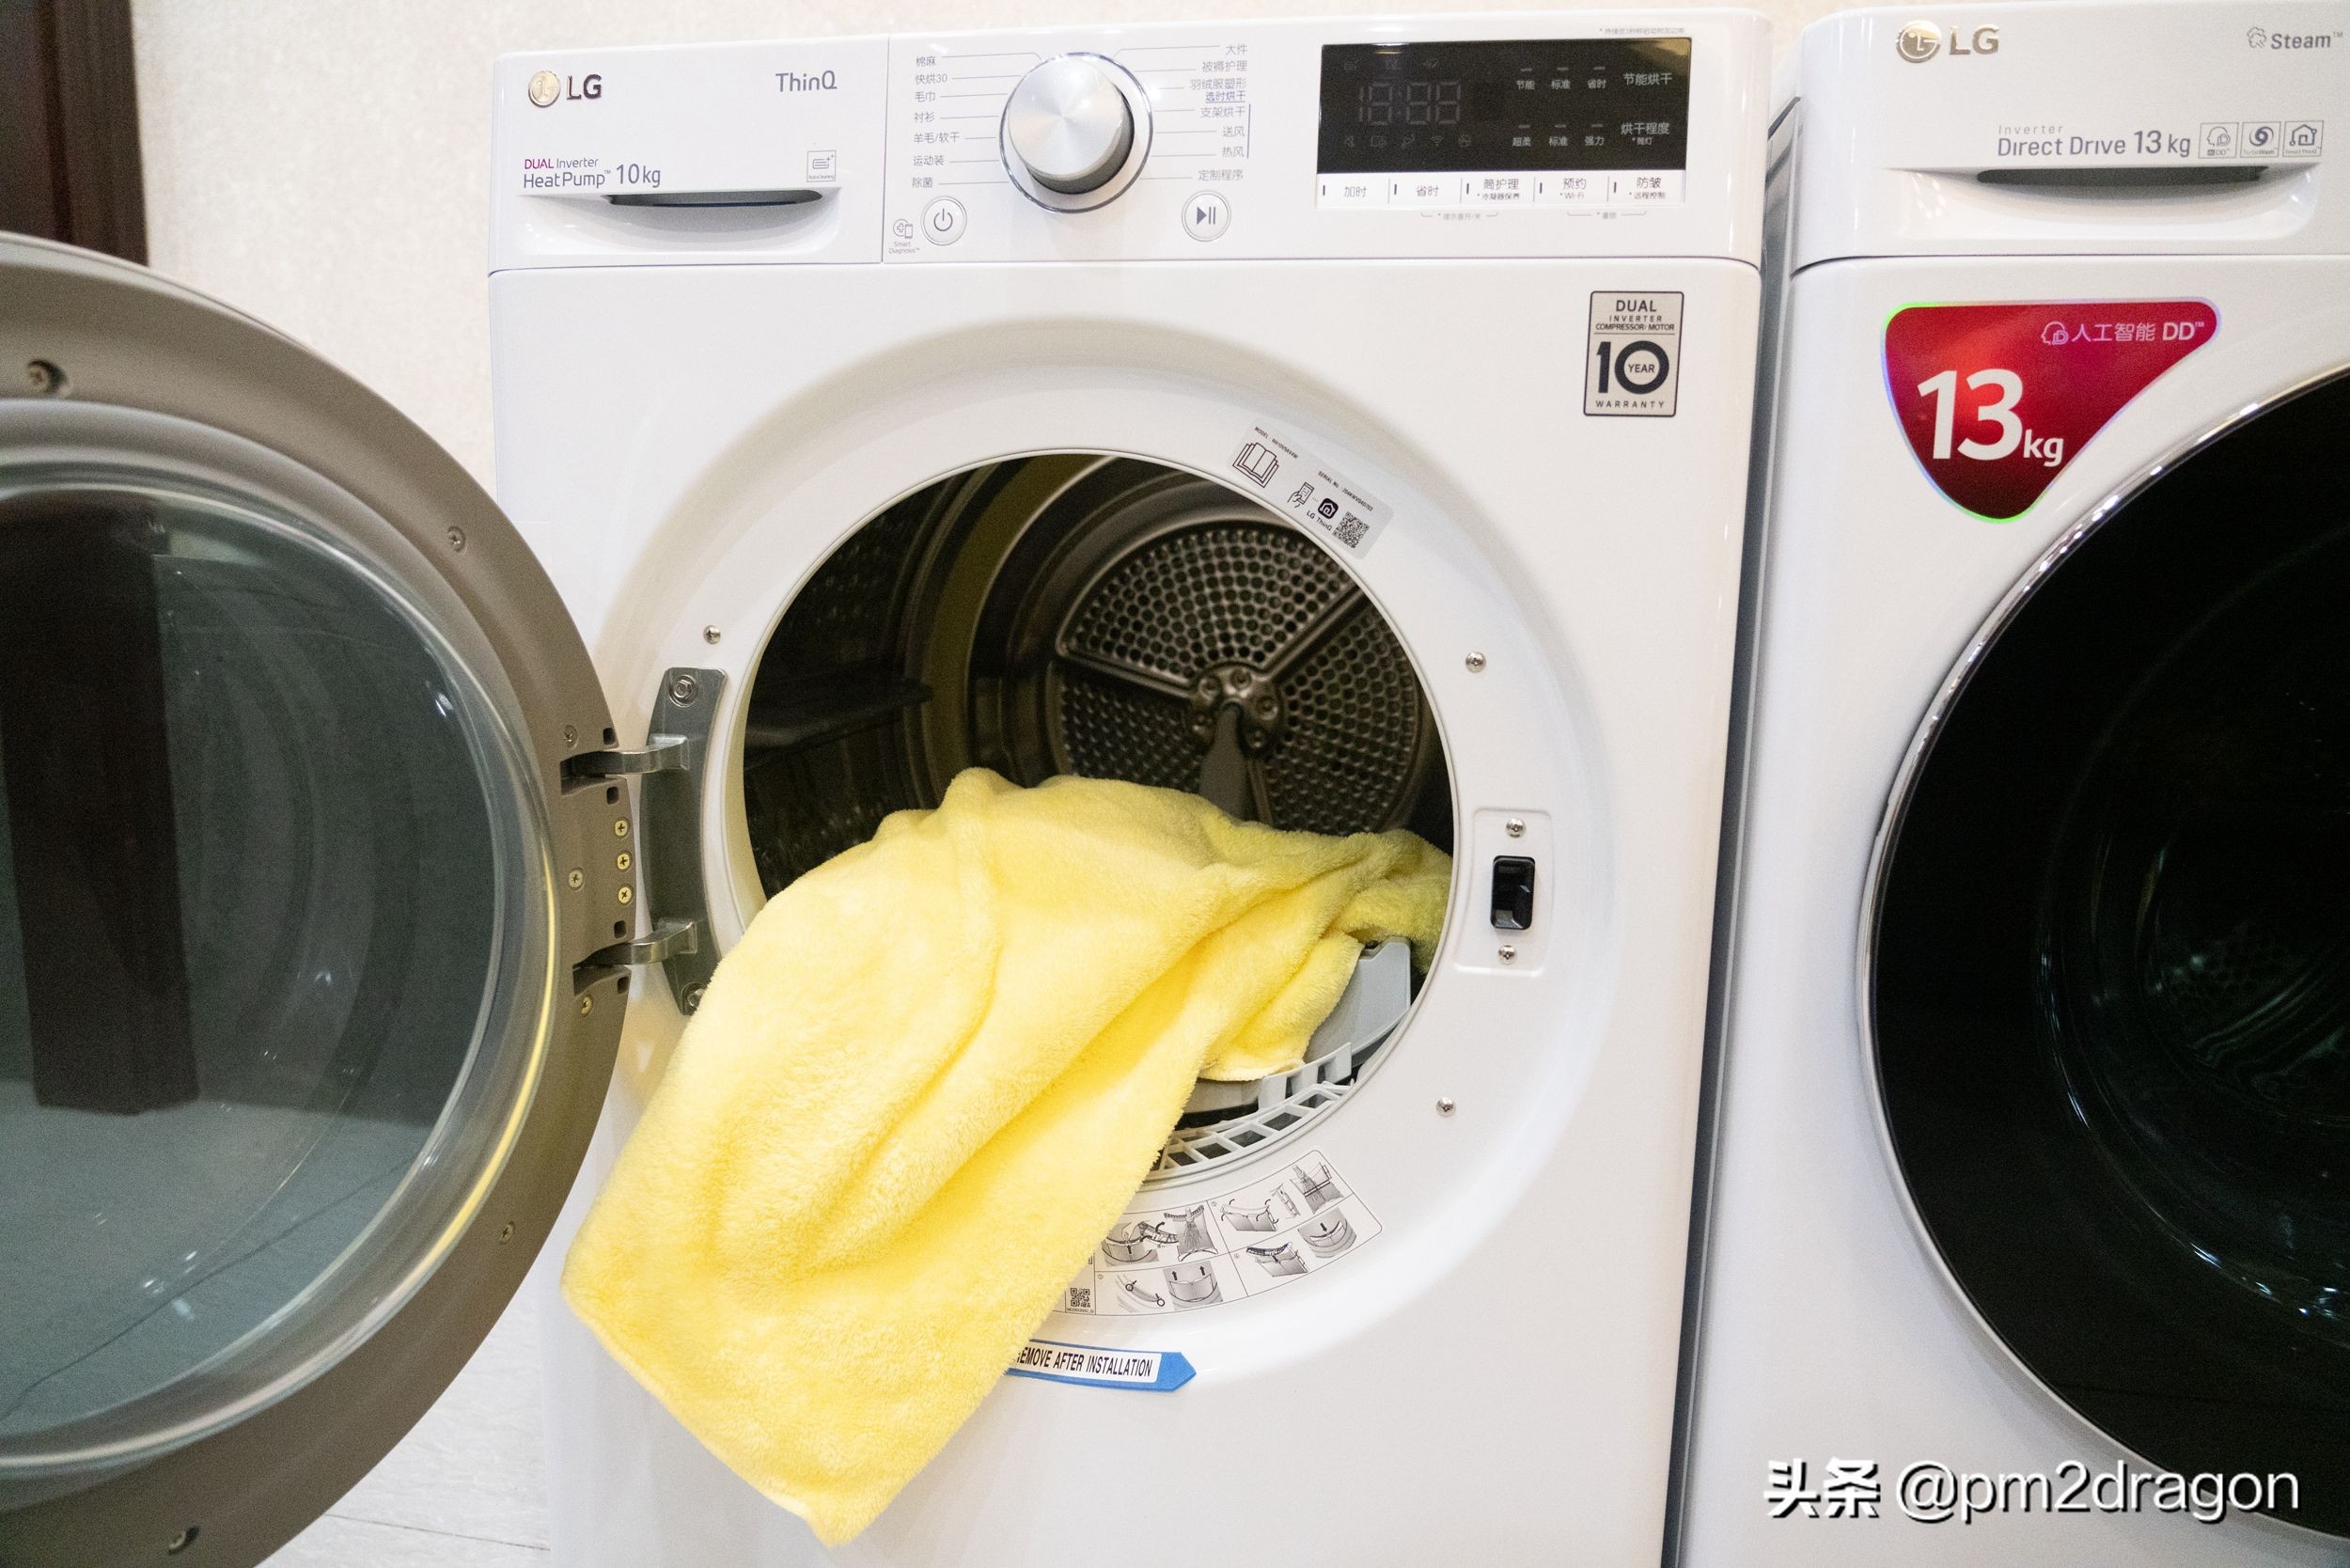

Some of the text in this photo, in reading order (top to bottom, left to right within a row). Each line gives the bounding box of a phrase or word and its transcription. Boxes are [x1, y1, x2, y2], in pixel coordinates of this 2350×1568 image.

[1949, 24, 2000, 55] LG
[1225, 44, 1247, 55] 大件
[916, 56, 936, 67] 棉麻
[776, 70, 838, 93] ThinQ
[915, 73, 948, 85] 快烘30
[1623, 72, 1673, 86] 节能烘干
[566, 73, 603, 100] LG
[915, 91, 936, 102] 毛巾
[914, 112, 935, 123] 衬衫
[1223, 126, 1245, 137] 送风
[1621, 121, 1670, 134] 烘干程度
[1998, 124, 2063, 135] Inverter
[913, 132, 960, 144] 羊毛/软干
[1222, 146, 1245, 158] 热风
[1998, 135, 2062, 157] Direct
[2069, 135, 2126, 156] Drive
[525, 157, 599, 169] DUAL Inverter
[913, 155, 945, 166] 运动装
[1198, 169, 1244, 181] 定制程序
[911, 177, 933, 188] 除菌
[1563, 178, 1587, 190] 预约
[1637, 177, 1662, 189] 防皱
[1344, 186, 1367, 197] 加时
[1417, 185, 1439, 197] 省时
[1616, 300, 1657, 312] DUAL
[2072, 321, 2155, 342] 人工智能
[1596, 340, 1669, 395] 10
[1628, 364, 1655, 373] YEAR
[1306, 510, 1333, 531] LG ThinQ
[1053, 1351, 1085, 1372] AFTER
[1086, 1355, 1153, 1377] INSTALLATION
